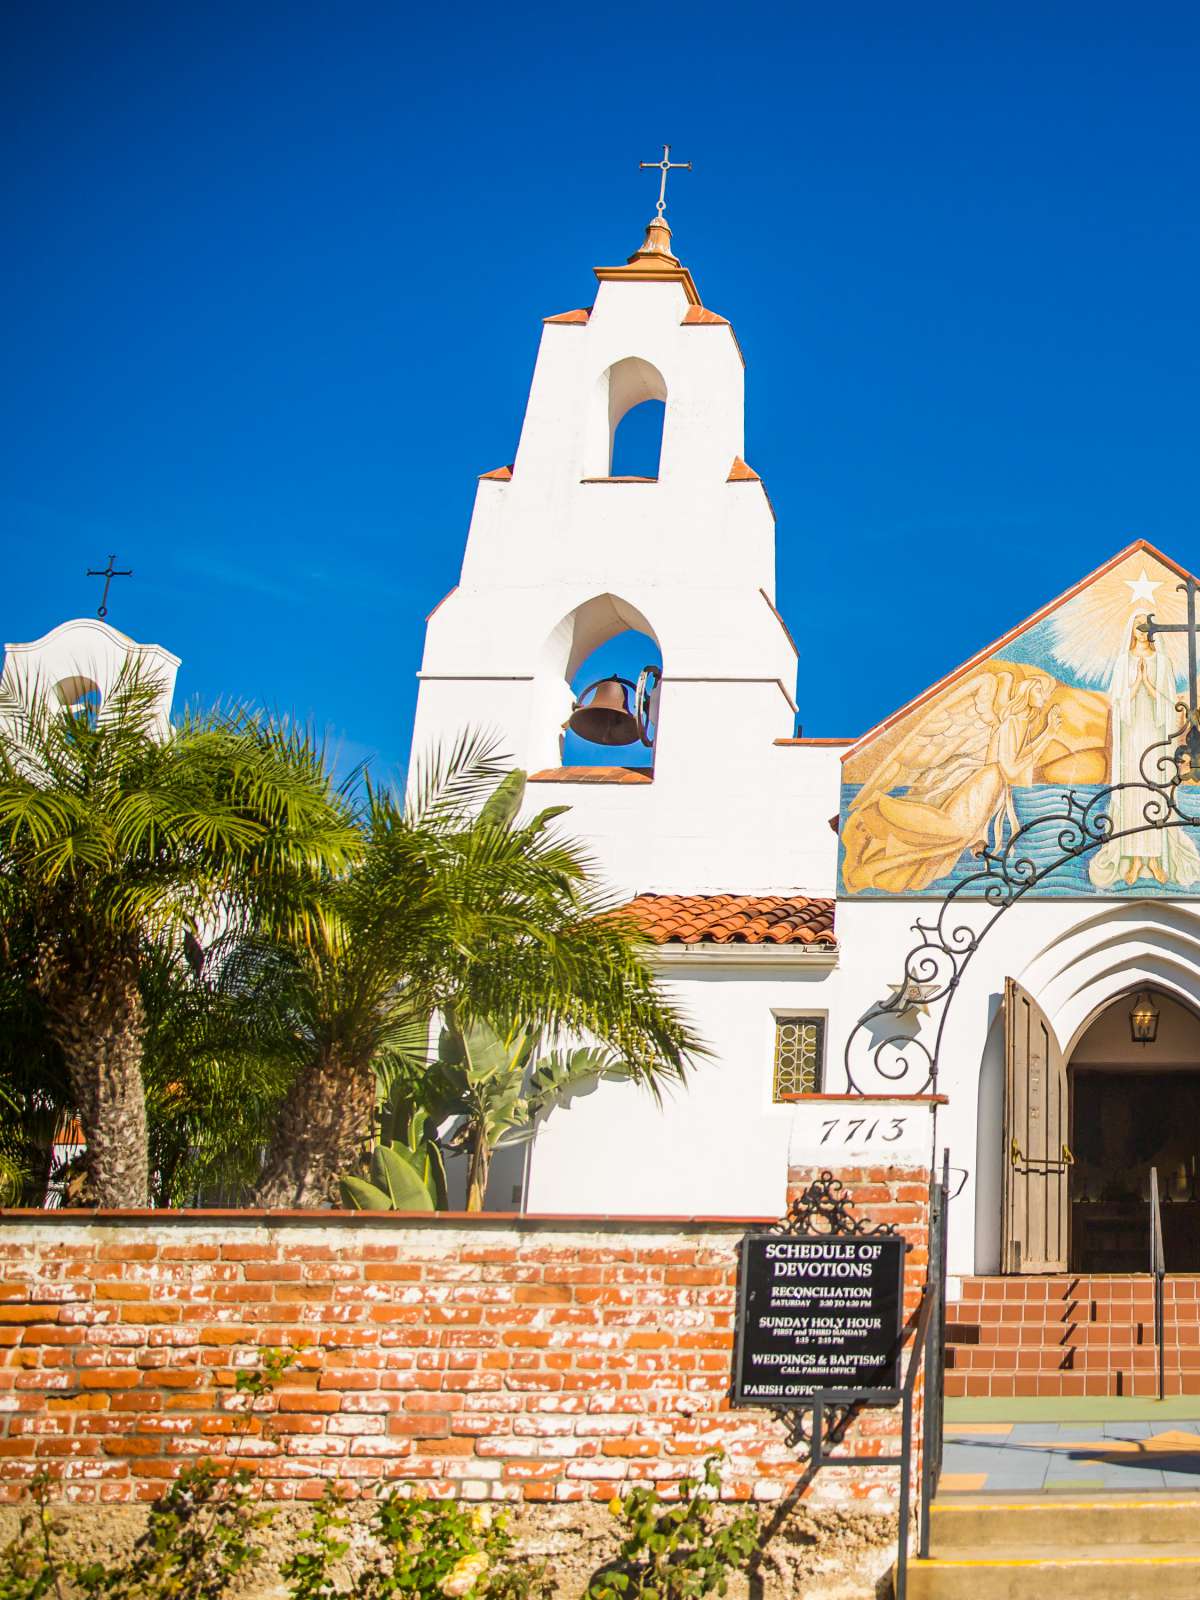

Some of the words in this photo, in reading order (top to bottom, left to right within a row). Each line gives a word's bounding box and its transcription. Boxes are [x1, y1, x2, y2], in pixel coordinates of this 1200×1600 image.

[820, 1118, 907, 1144] 7713
[766, 1244, 855, 1258] SCHEDULE
[858, 1245, 882, 1258] OF
[774, 1262, 872, 1277] DEVOTIONS
[772, 1287, 872, 1298] RECONCILIATION
[759, 1317, 810, 1328] SUNDAY
[811, 1318, 844, 1328] HOLY
[846, 1318, 881, 1328] HOUR
[752, 1354, 816, 1365] WEDDINGS
[818, 1355, 827, 1365] &
[830, 1355, 886, 1366] BAPTISMS
[744, 1385, 783, 1394] PARISH
